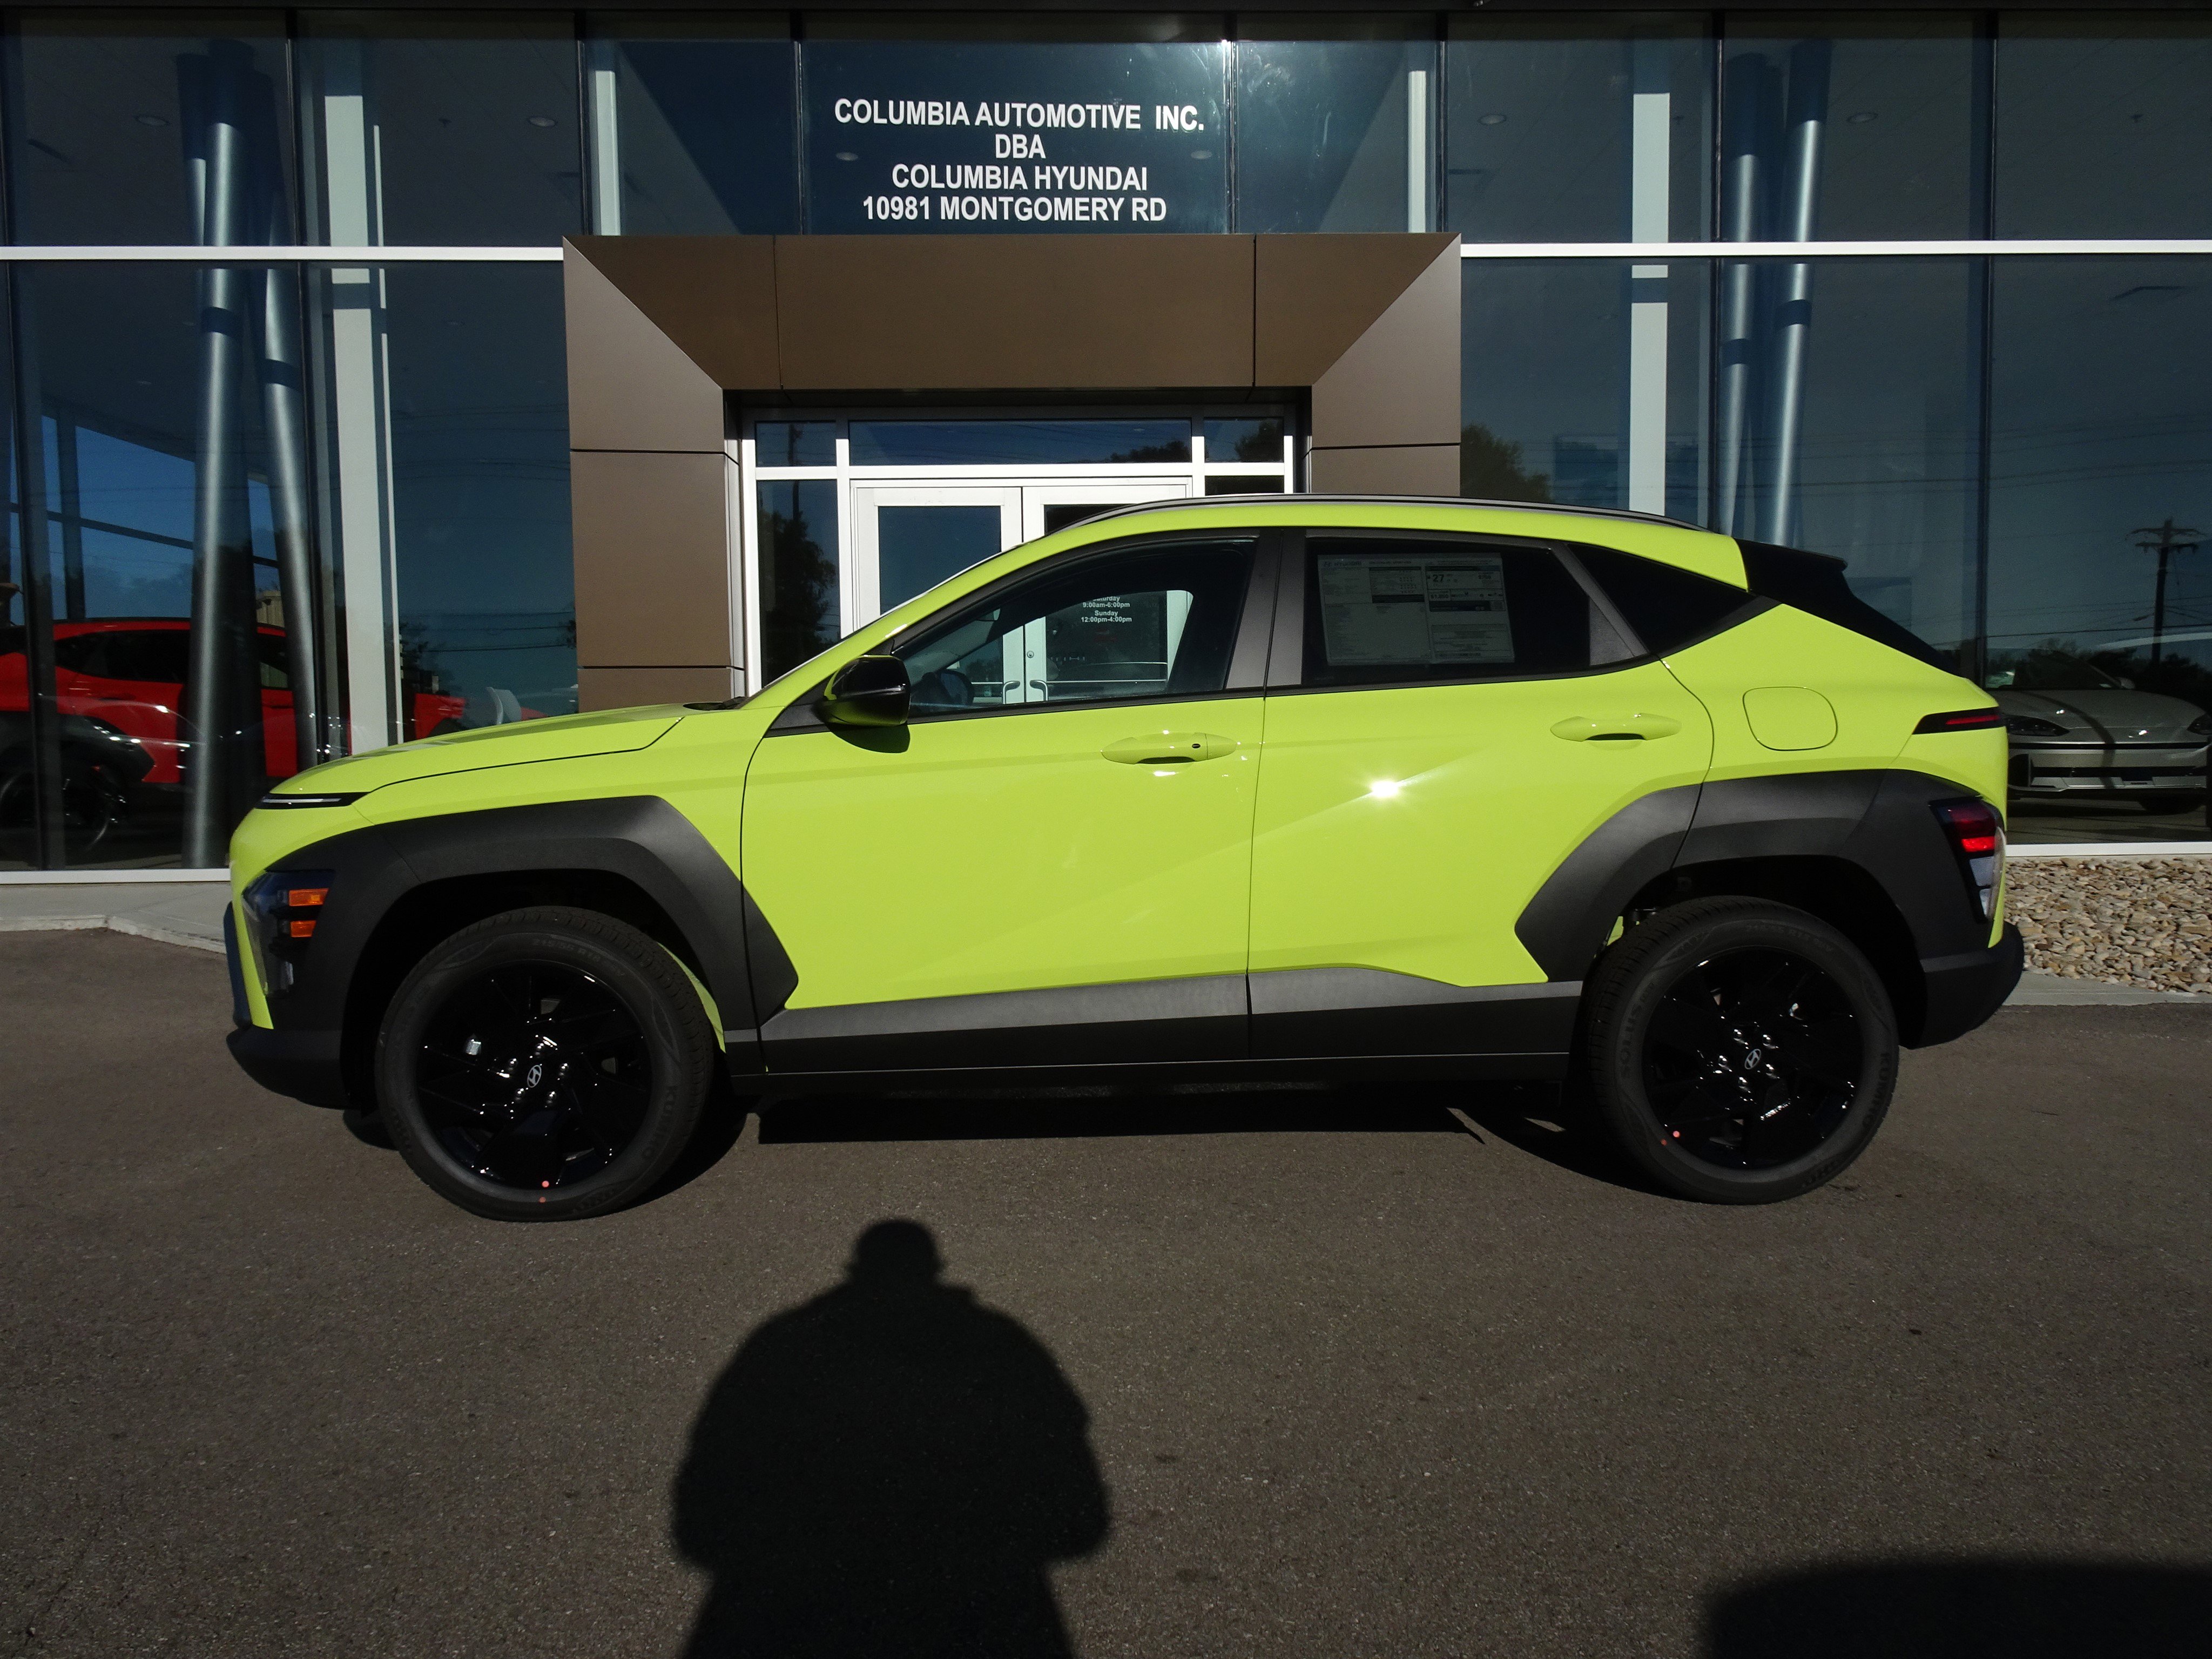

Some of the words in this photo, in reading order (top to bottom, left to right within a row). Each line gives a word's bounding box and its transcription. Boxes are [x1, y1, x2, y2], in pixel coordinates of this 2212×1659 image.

[834, 98, 970, 126] COLUMBIA
[975, 102, 1141, 130] AUTOMOTIVE
[1155, 105, 1204, 131] INC.
[995, 134, 1046, 159] DBA
[892, 164, 1028, 190] COLUMBIA
[1035, 165, 1147, 191] HYUNDAI
[863, 196, 930, 220] 10981
[940, 196, 1124, 221] MONTGOMERY
[1132, 197, 1166, 221] RD
[1432, 574, 1444, 582] 27
